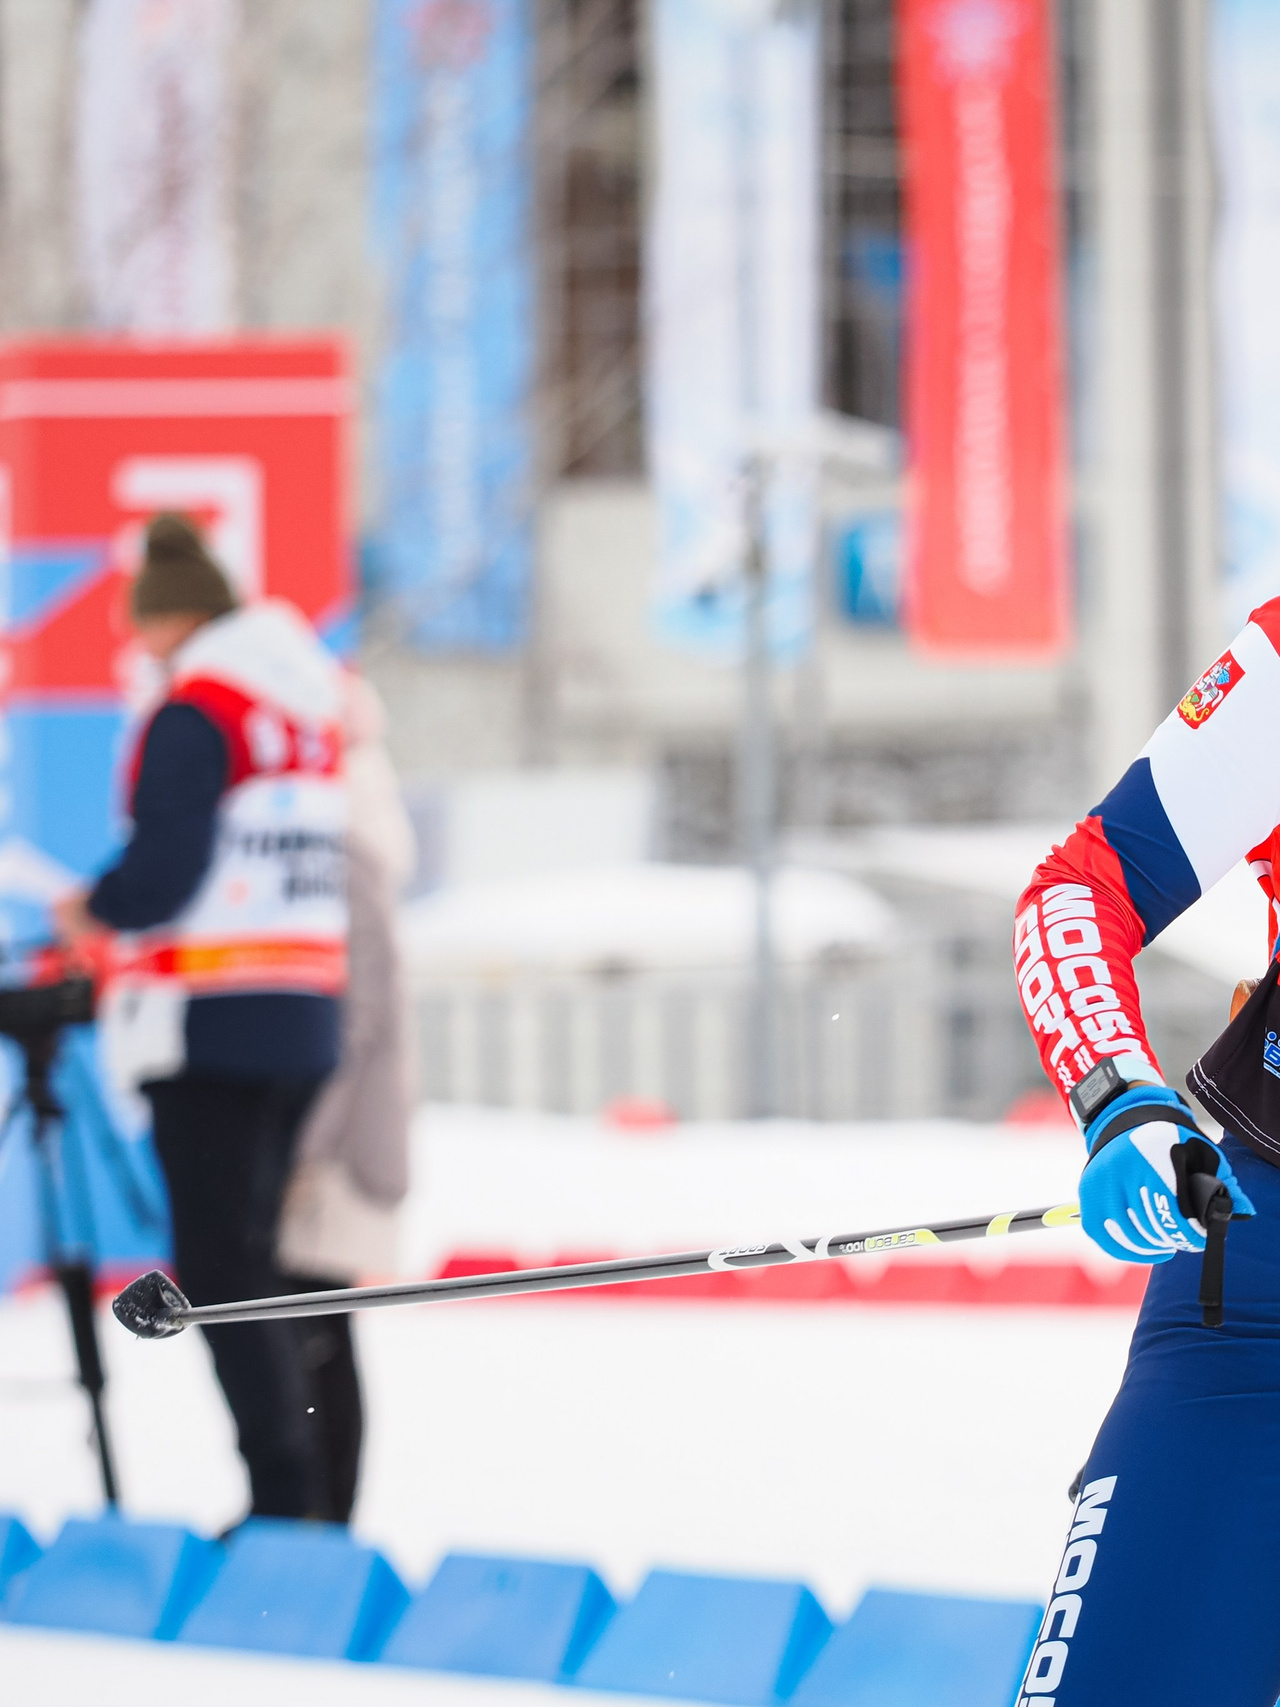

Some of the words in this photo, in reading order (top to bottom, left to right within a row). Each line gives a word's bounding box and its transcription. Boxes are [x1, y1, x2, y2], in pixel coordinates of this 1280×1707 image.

[1153, 1192, 1178, 1229] SKI
[839, 1240, 864, 1254] 100%
[1021, 1475, 1118, 1707] МОСО
